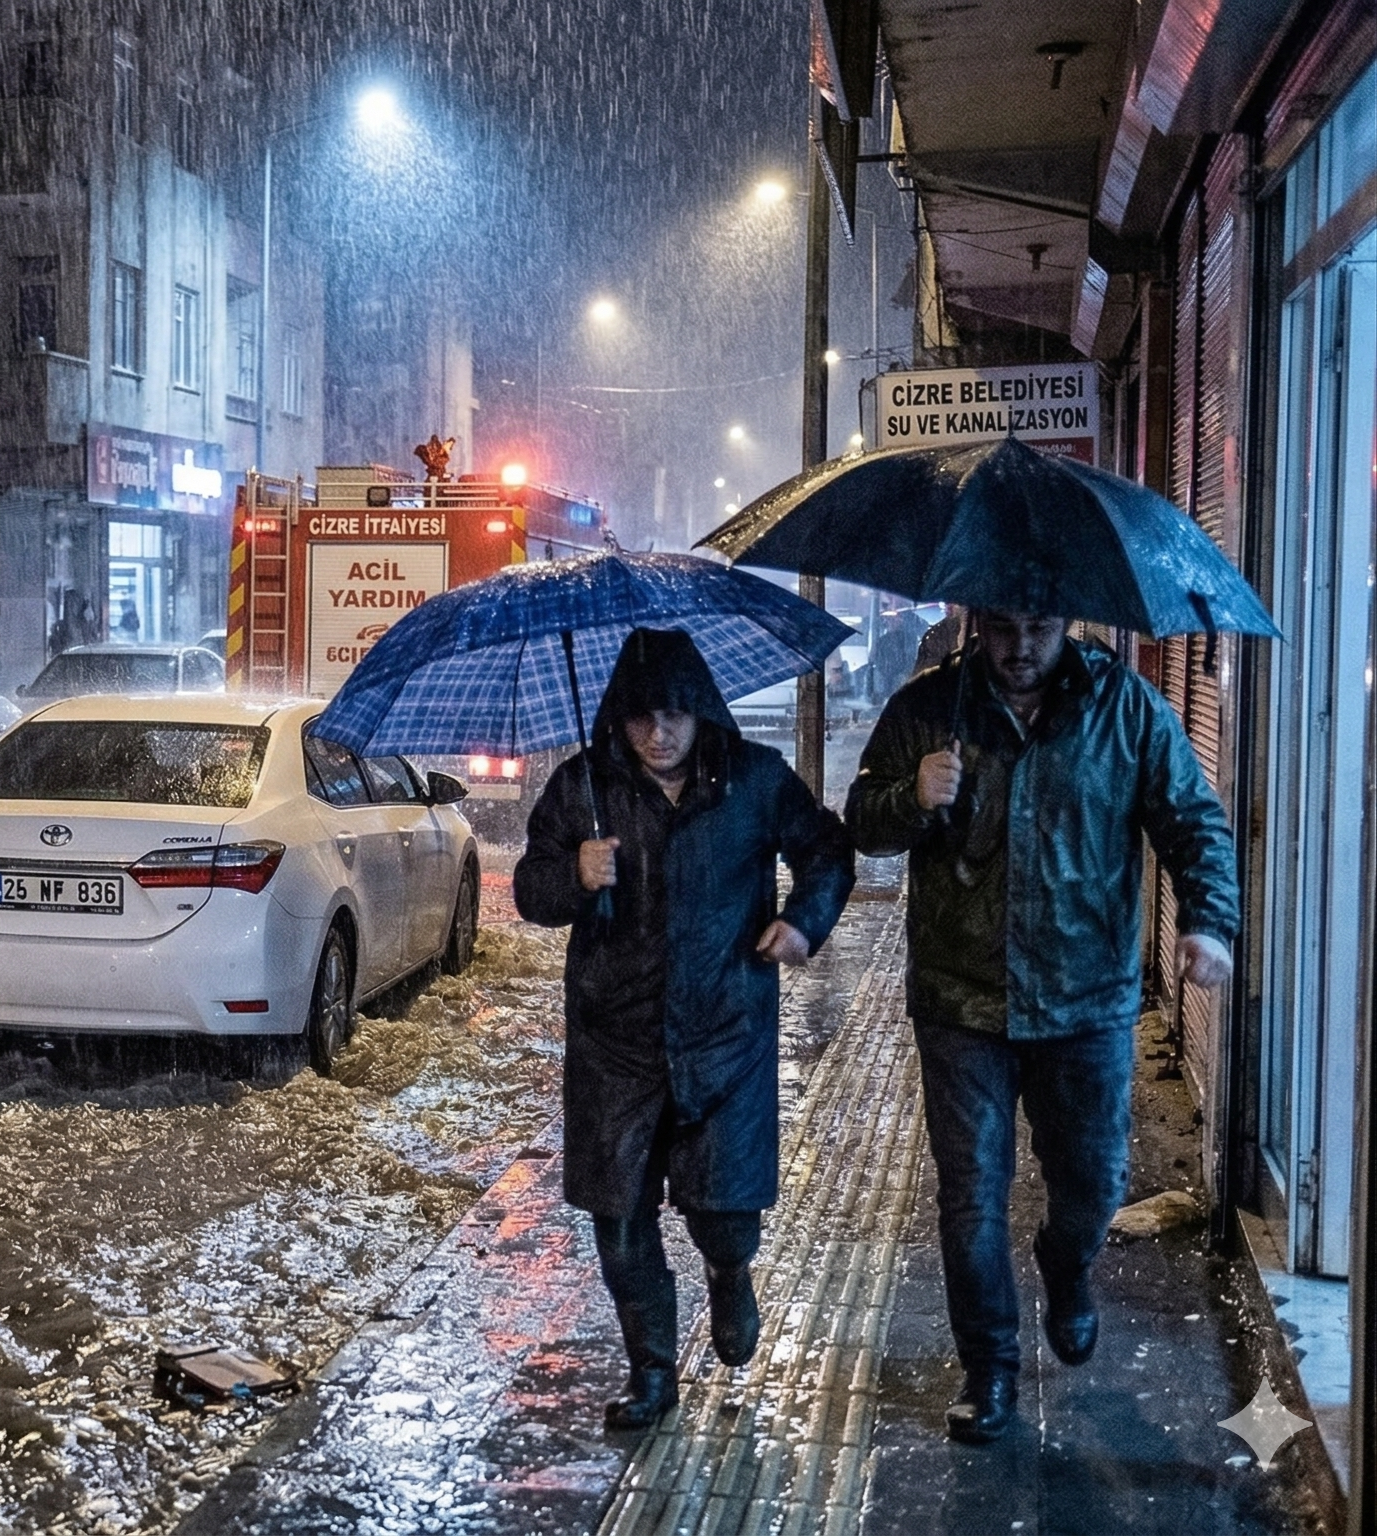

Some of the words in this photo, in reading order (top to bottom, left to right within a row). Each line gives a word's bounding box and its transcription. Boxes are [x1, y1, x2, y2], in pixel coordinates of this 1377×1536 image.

[892, 379, 953, 407] CİZRE
[960, 370, 1084, 404] BELEDİYESİ
[887, 415, 911, 437] SU
[917, 413, 941, 435] VE
[946, 404, 1088, 435] KANALİZASYON
[309, 513, 359, 535] CİZRE
[364, 513, 446, 535] İTFAİYESİ
[347, 558, 406, 581] ACİL
[328, 589, 426, 609] YARDIM
[4, 878, 28, 900] 25
[40, 880, 65, 902] NF
[78, 881, 116, 904] 836
